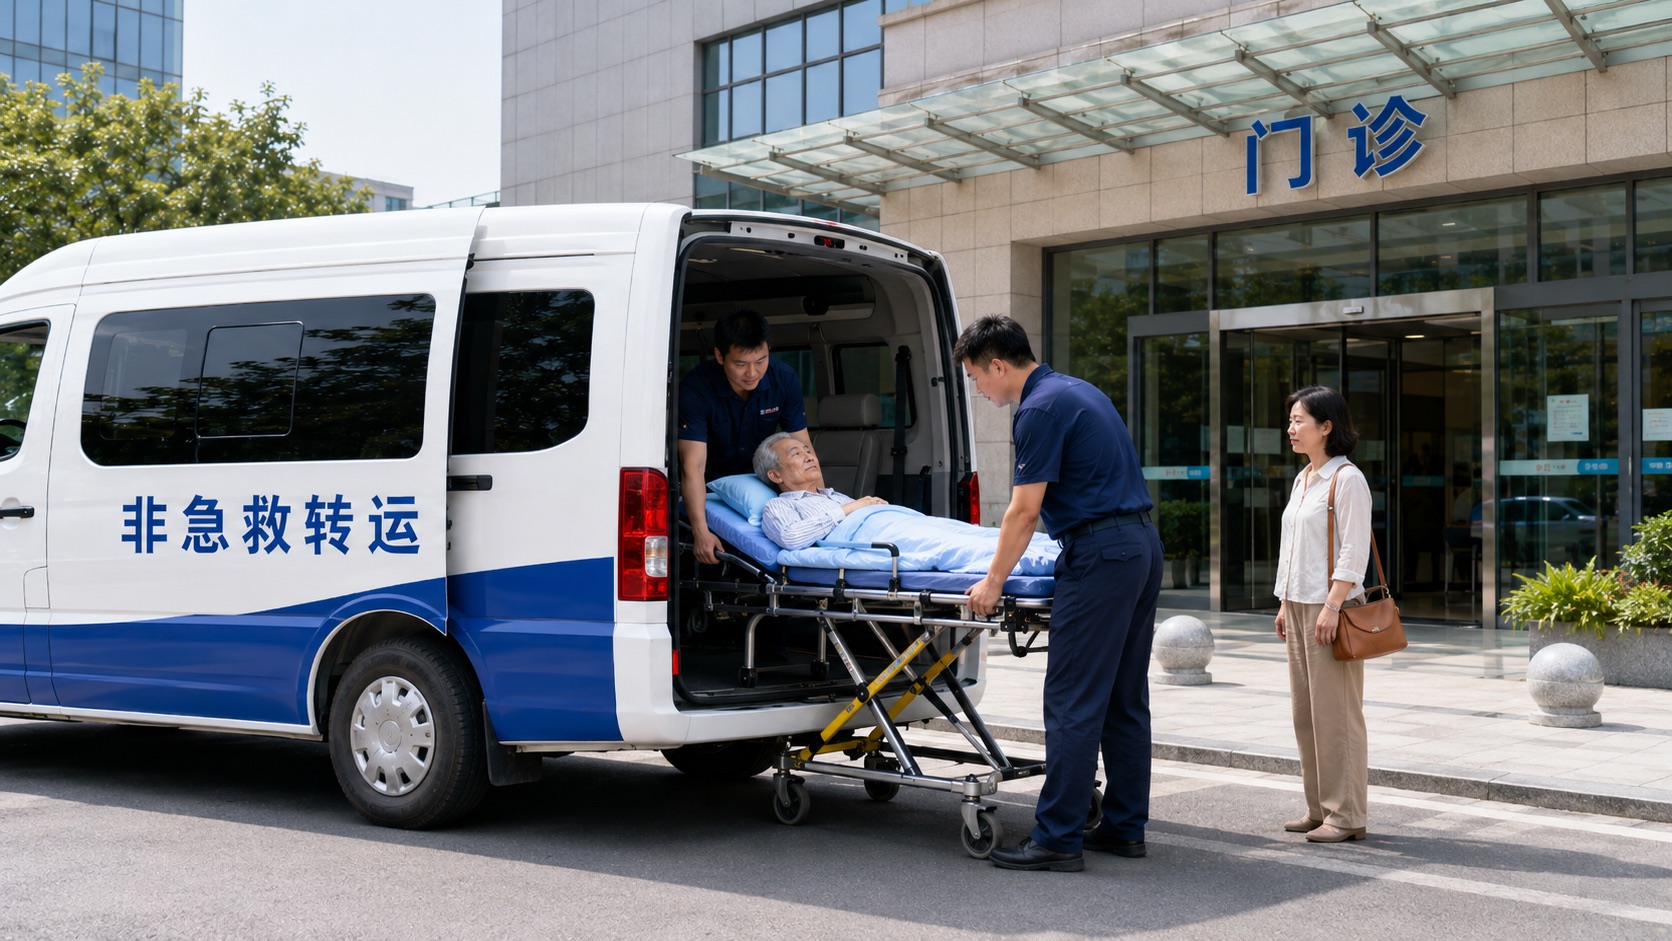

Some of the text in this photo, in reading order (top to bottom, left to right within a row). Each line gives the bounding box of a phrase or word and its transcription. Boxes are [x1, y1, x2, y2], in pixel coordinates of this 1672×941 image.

[1246, 95, 1429, 195] 门诊
[121, 494, 420, 555] 非急救转运
